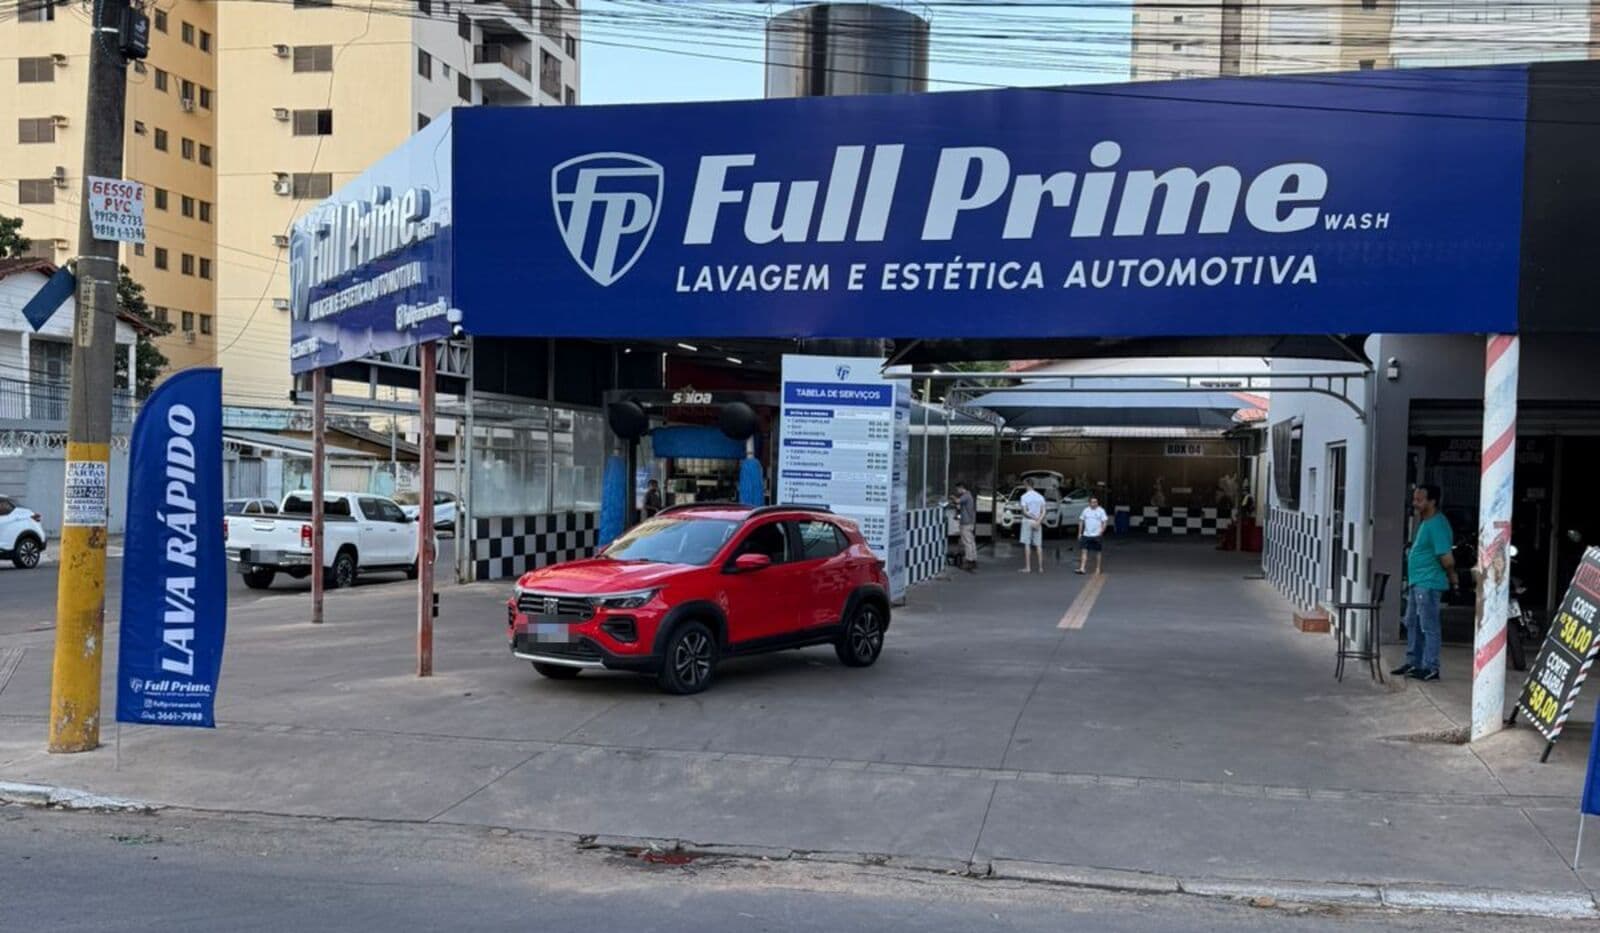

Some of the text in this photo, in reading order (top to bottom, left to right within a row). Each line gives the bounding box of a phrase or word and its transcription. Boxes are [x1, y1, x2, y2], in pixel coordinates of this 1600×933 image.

[93, 181, 143, 201] GESSO E
[104, 198, 132, 213] PVC
[683, 140, 1390, 245] Full Prime WASH
[309, 204, 348, 288] Full
[345, 184, 420, 272] Prime
[676, 254, 1319, 293] LAVAGEM E ESTÉTICA AUTOMOTIVA
[795, 388, 881, 400] TABELA DE SERVIÇOS
[157, 403, 197, 568] RÁPIDO
[1571, 596, 1598, 624] CORTE
[161, 576, 196, 676] LAVA
[1546, 651, 1571, 681] CORTE
[144, 680, 170, 692] Full
[170, 680, 211, 693] Prime
